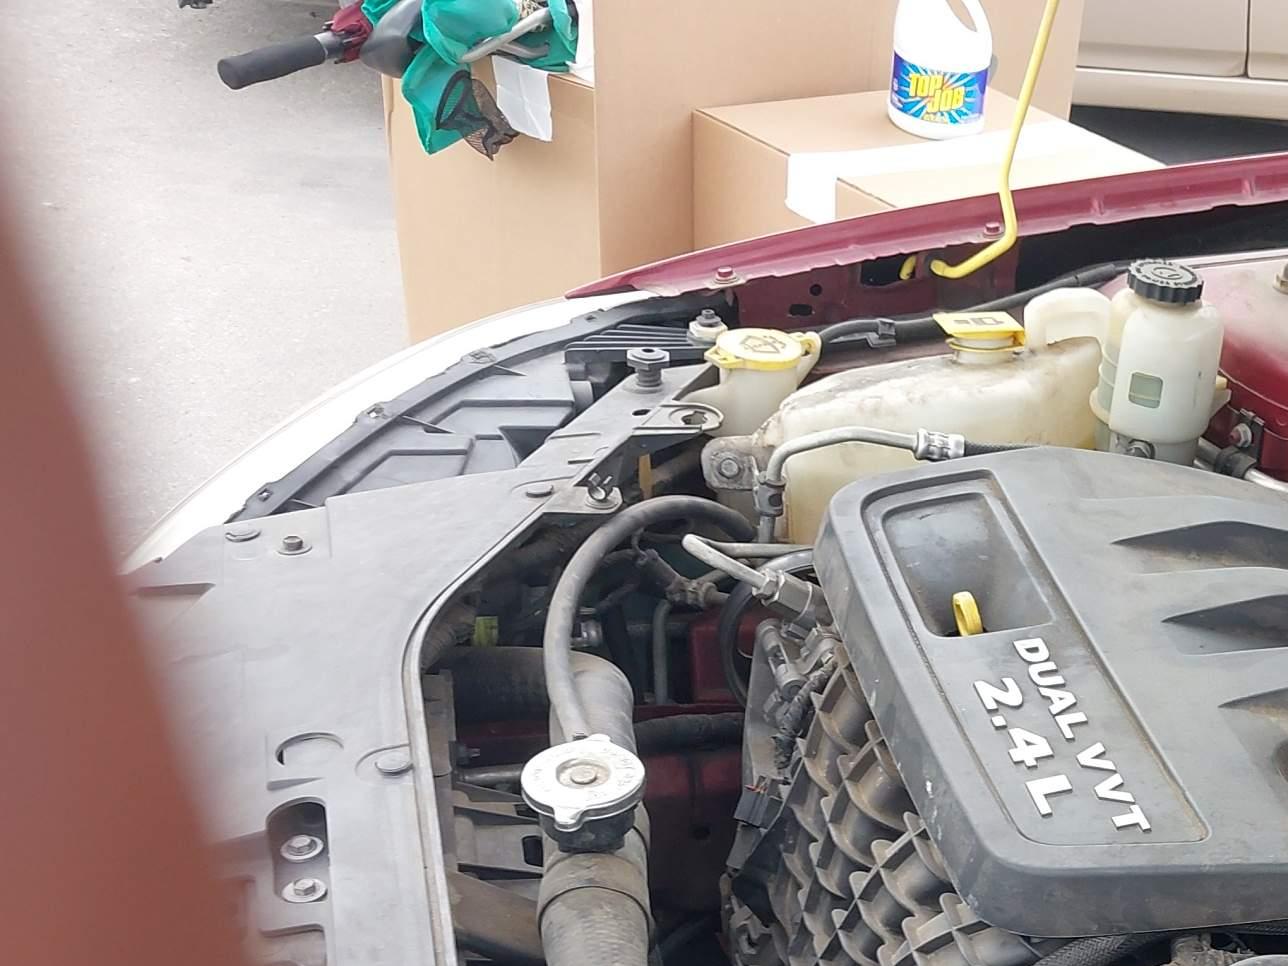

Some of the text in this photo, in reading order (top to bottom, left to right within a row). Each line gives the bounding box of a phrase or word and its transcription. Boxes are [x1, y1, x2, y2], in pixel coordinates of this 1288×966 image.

[908, 73, 944, 97] TOP
[926, 87, 965, 114] JOB
[973, 677, 1073, 817] 2.4L
[1012, 637, 1151, 832] DUAL VVT
